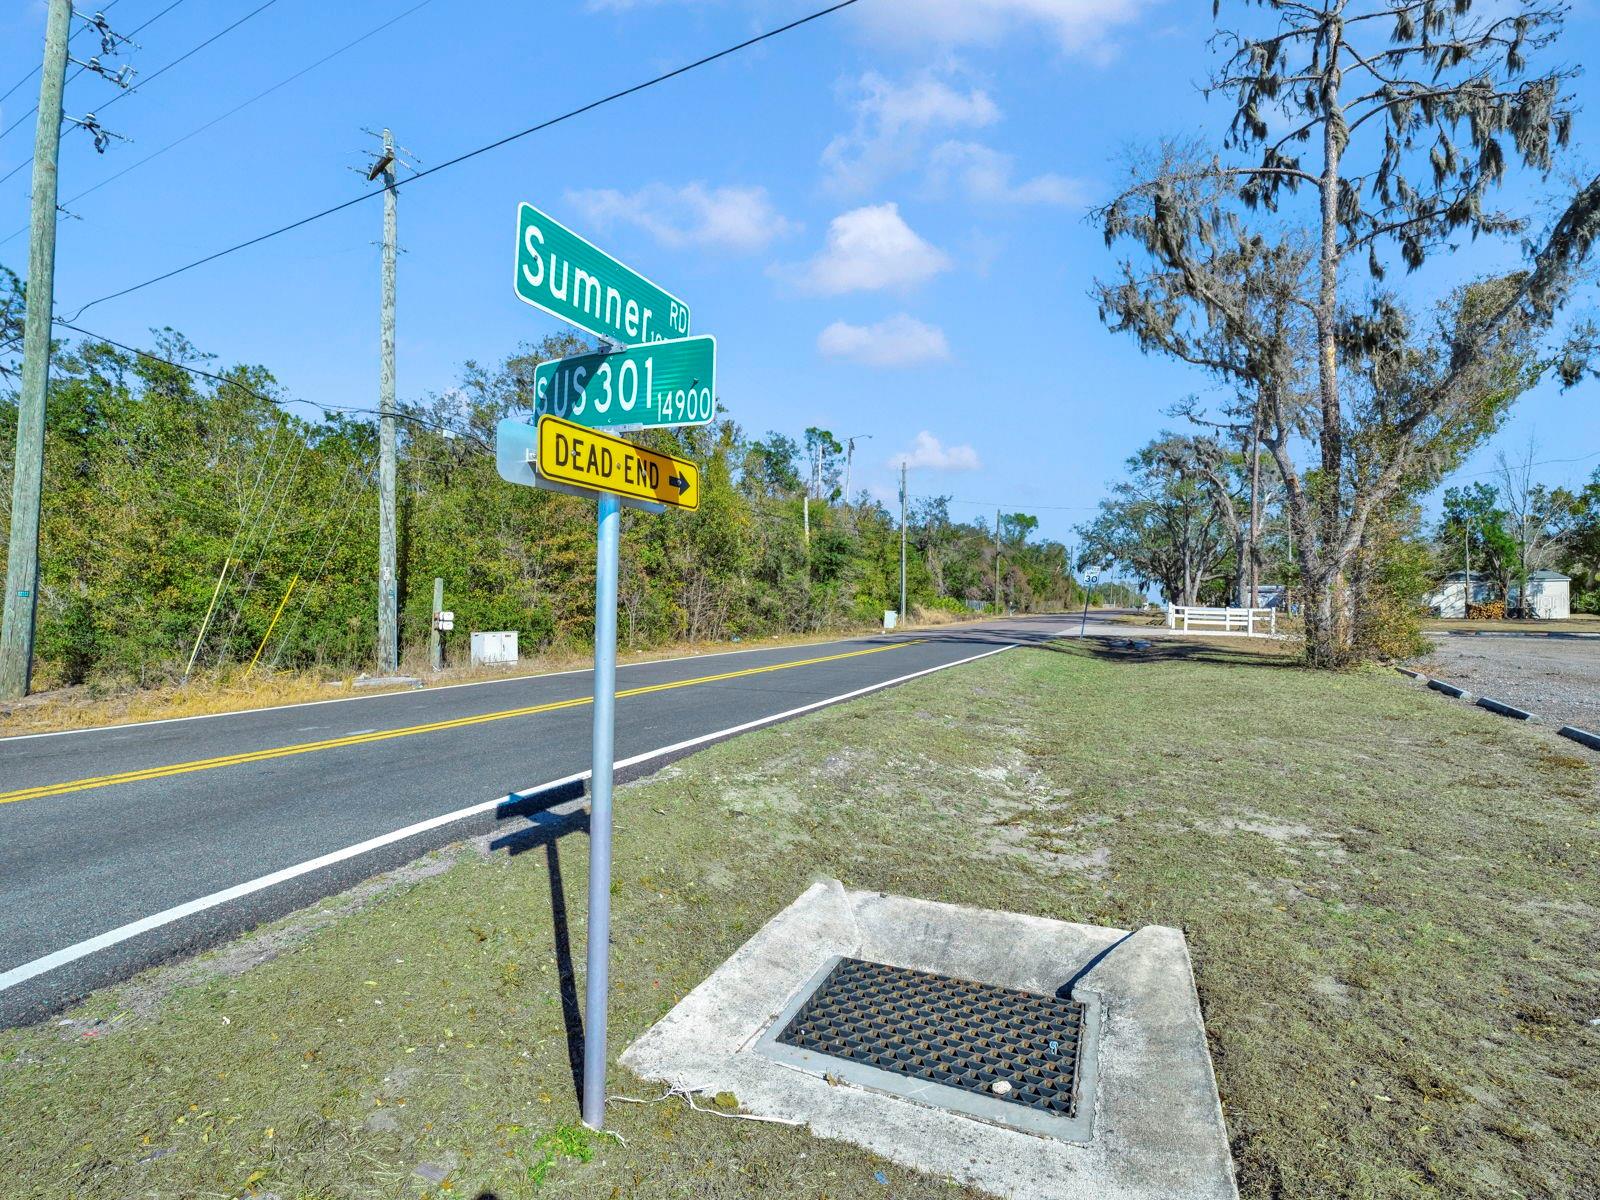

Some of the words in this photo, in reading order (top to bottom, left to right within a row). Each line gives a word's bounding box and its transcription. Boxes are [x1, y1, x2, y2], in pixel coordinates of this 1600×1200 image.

[522, 225, 653, 343] Sumner
[670, 300, 687, 334] RD
[536, 376, 548, 417] S
[553, 366, 587, 418] US
[594, 357, 653, 414] 301
[657, 387, 711, 422] 14900
[555, 432, 613, 478] DEAD
[624, 454, 660, 490] END
[1084, 575, 1098, 583] 30
